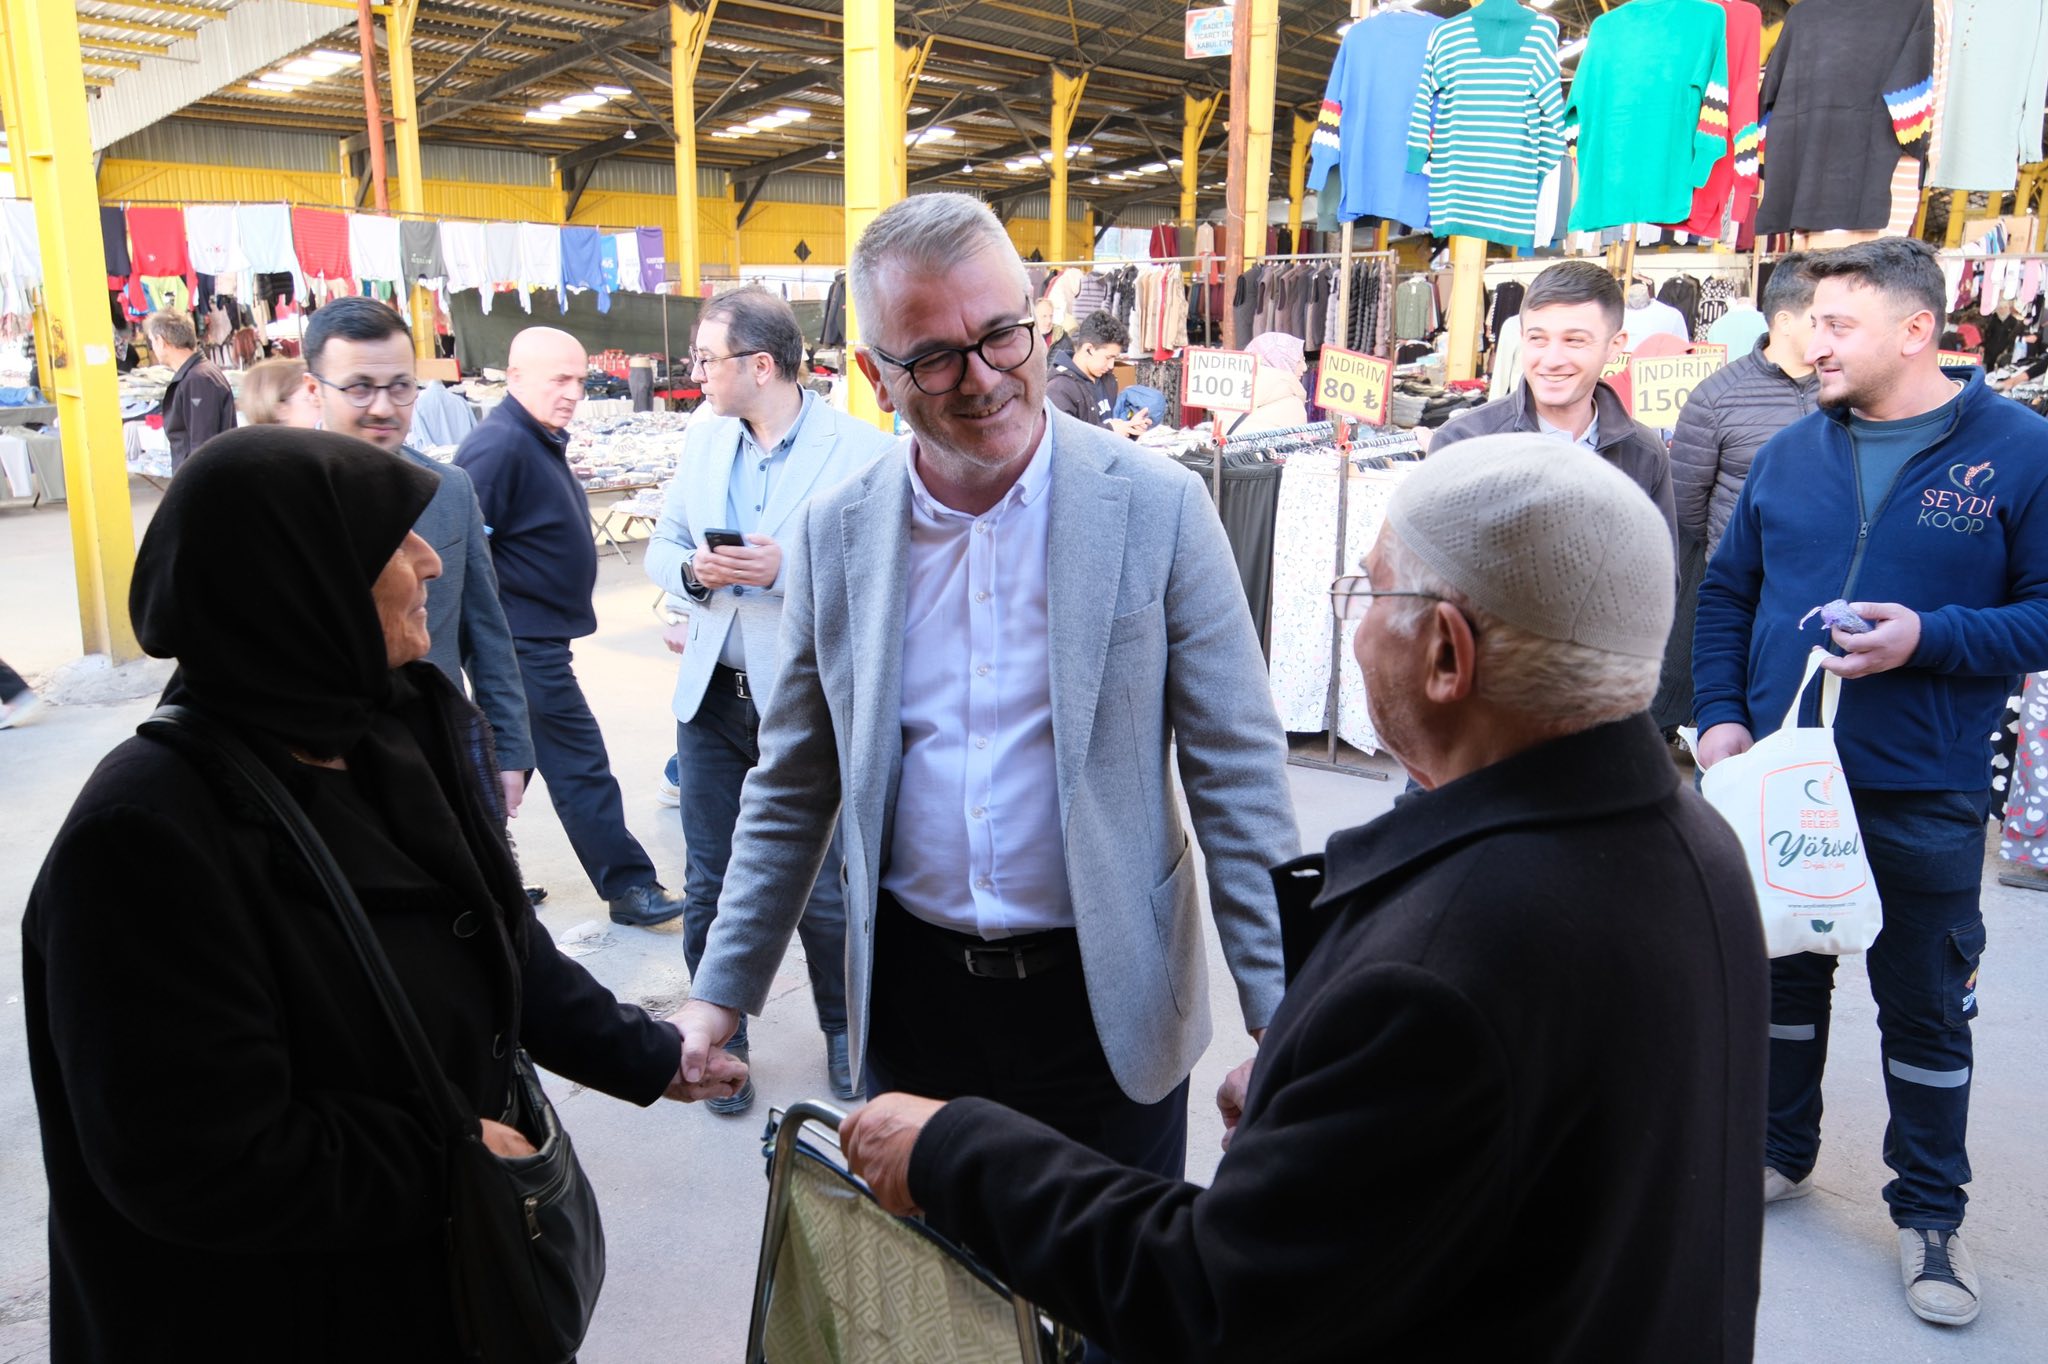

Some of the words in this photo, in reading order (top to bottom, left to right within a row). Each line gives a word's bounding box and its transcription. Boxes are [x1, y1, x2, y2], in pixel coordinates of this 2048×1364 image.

[1324, 351, 1386, 386] İNDİRİM
[1638, 356, 1721, 384] İNDİRİM
[1192, 374, 1234, 397] 100
[1324, 377, 1355, 403] 80
[1638, 387, 1690, 412] 150
[1921, 488, 1996, 518] SEYDİ
[1917, 508, 1984, 535] KOOP
